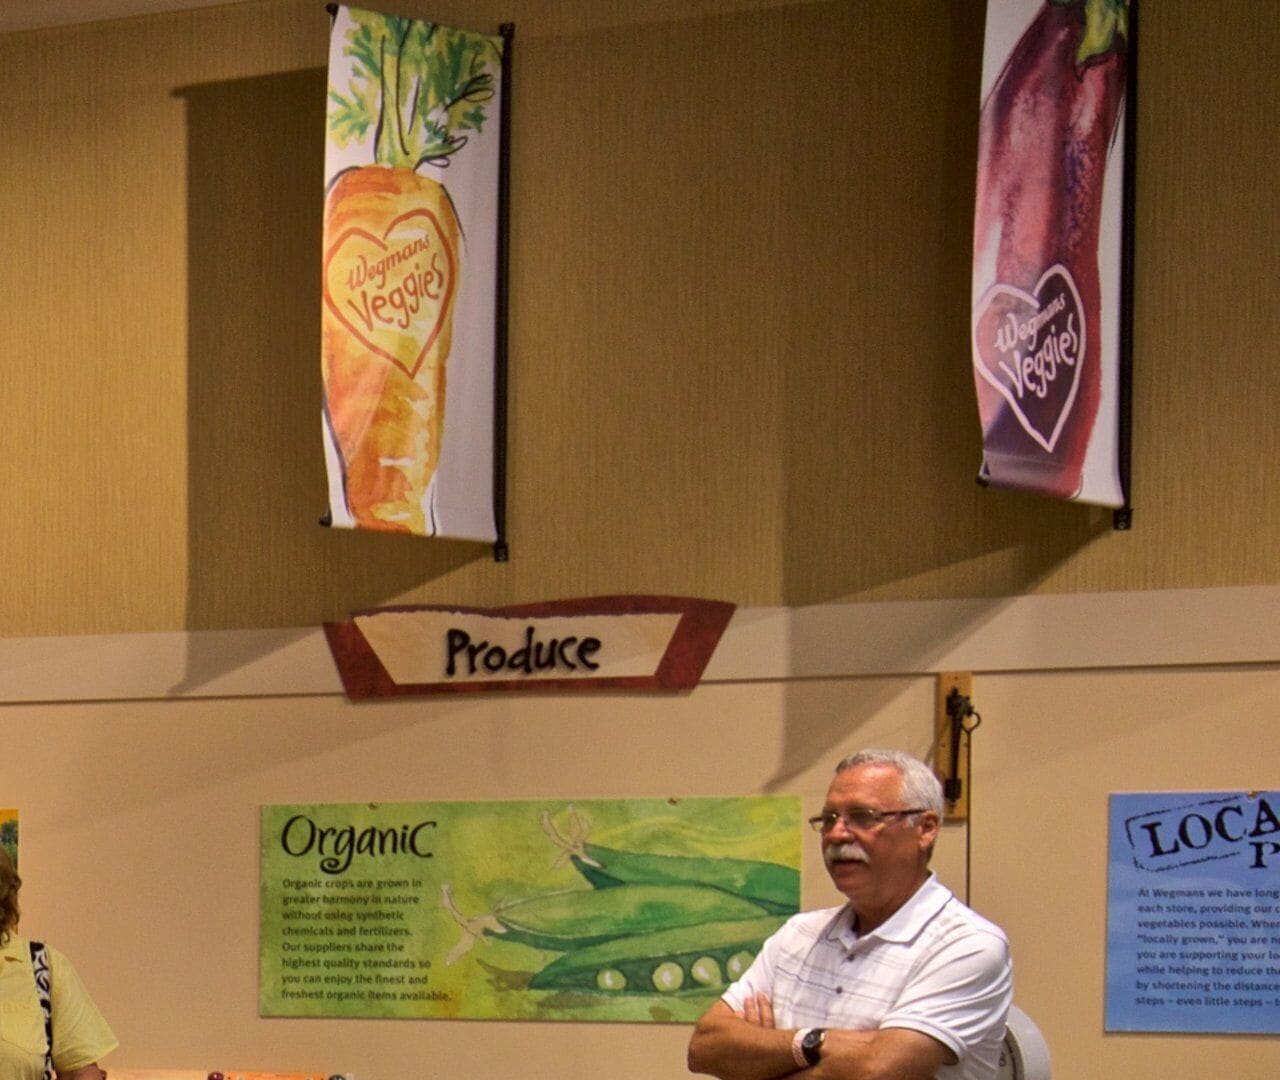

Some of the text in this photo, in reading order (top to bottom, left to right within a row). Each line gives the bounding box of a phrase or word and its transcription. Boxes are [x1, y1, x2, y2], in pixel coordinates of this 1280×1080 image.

[346, 234, 431, 291] Wegmans
[347, 252, 444, 333] Veggies
[994, 292, 1066, 353] Wegmans
[998, 312, 1078, 400] Veggies
[445, 626, 603, 678] Produce
[282, 879, 422, 890] Organic crops are grown in
[1137, 888, 1280, 899] At Wegmans we have long
[282, 896, 321, 905] greater
[322, 896, 369, 905] harmony
[383, 896, 420, 905] nature
[1137, 903, 1272, 915] each store, providing our
[282, 911, 404, 921] without using synthetic
[1137, 919, 1197, 930] vegetables
[1199, 919, 1249, 930] possible.
[282, 926, 413, 936] chemicals and fertilizers.
[1227, 934, 1247, 945] you
[1250, 934, 1267, 945] are
[282, 942, 404, 952] Our suppliers share the
[1137, 950, 1157, 961] you
[1159, 950, 1176, 961] are
[1179, 950, 1239, 961] supporting
[1241, 950, 1266, 961] your
[282, 958, 431, 969] highest quality standards so
[1137, 965, 1263, 977] while helping to reduce
[281, 975, 428, 985] you can enjoy the finest and
[1136, 980, 1149, 992] by
[1152, 980, 1211, 992] shortening
[1213, 980, 1231, 992] the
[282, 990, 324, 1001] freshest
[327, 990, 364, 1001] organic
[368, 990, 397, 1001] items
[1135, 996, 1165, 1007] steps
[1176, 996, 1202, 1007] even
[1204, 996, 1230, 1007] little
[1233, 996, 1263, 1007] steps
